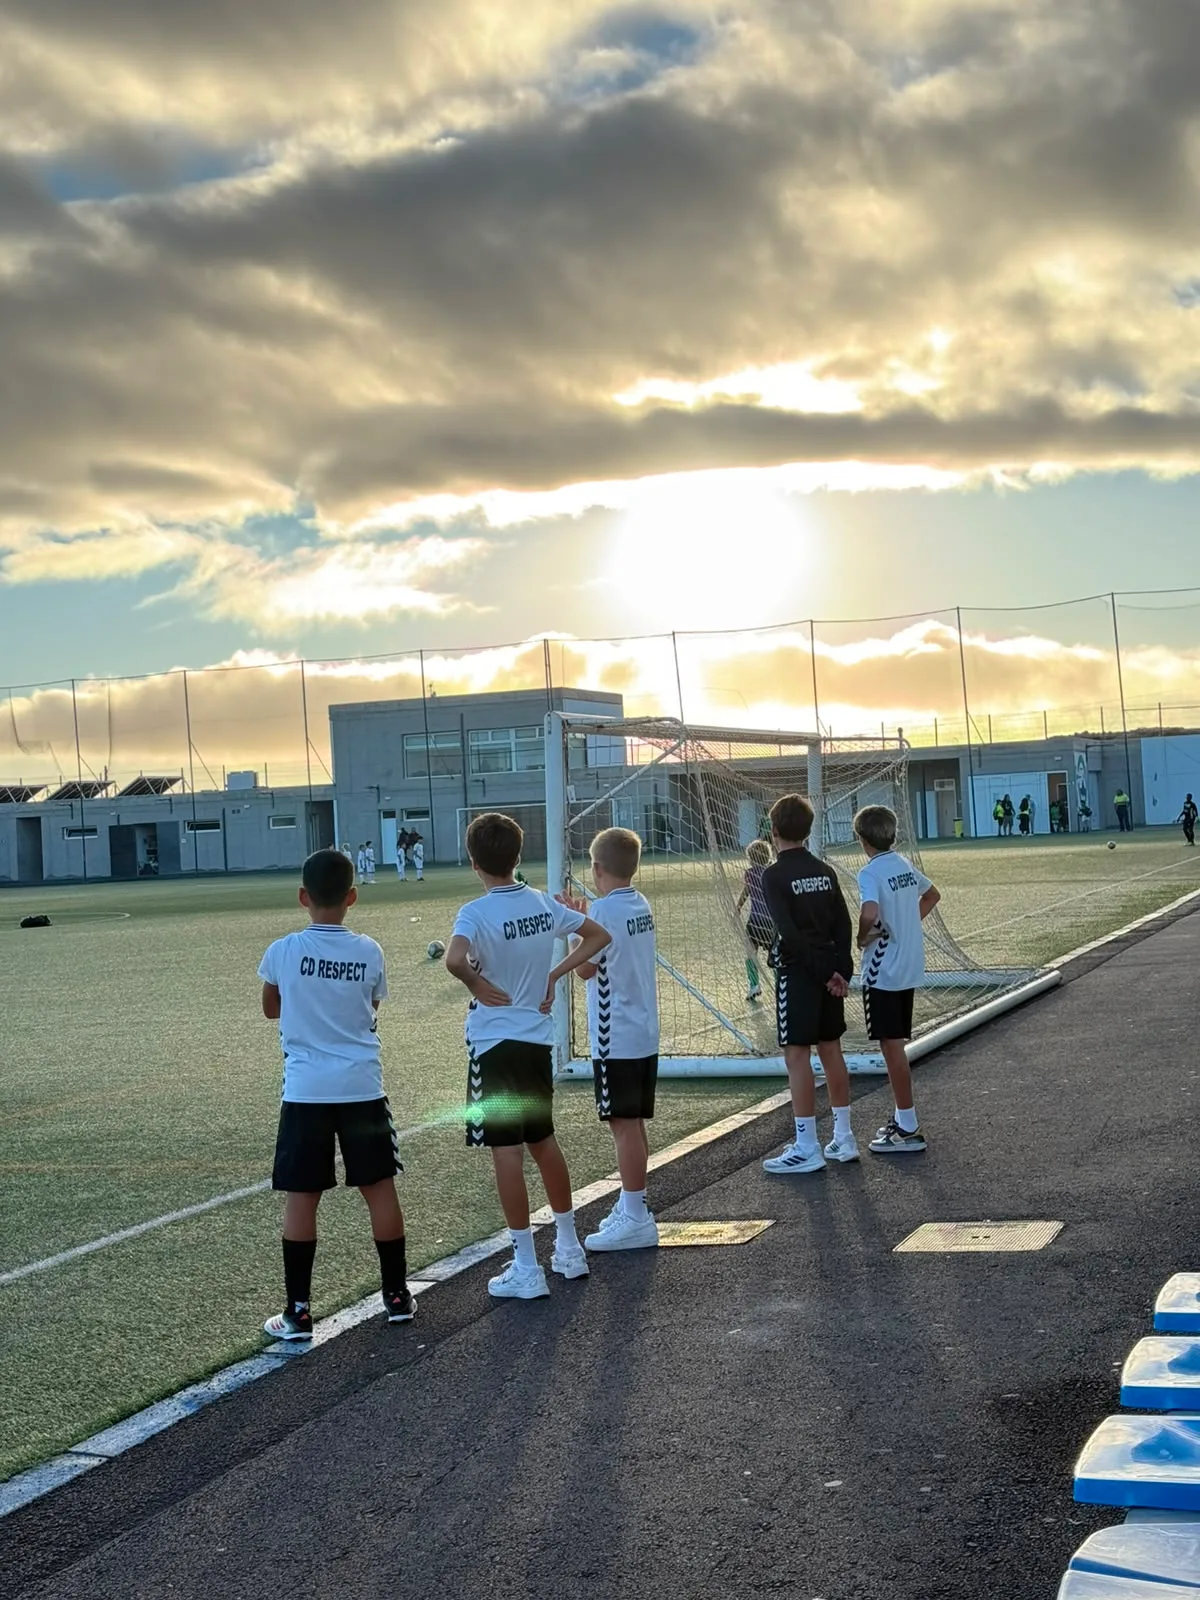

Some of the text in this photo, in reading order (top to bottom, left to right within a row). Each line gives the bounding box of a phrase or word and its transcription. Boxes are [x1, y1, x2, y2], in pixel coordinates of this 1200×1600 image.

[801, 876, 832, 893] RESPECT
[888, 872, 917, 891] CD RESPEC
[503, 920, 517, 941] CD
[627, 914, 654, 936] CD RESPEC
[300, 956, 367, 981] CD RESPECT
